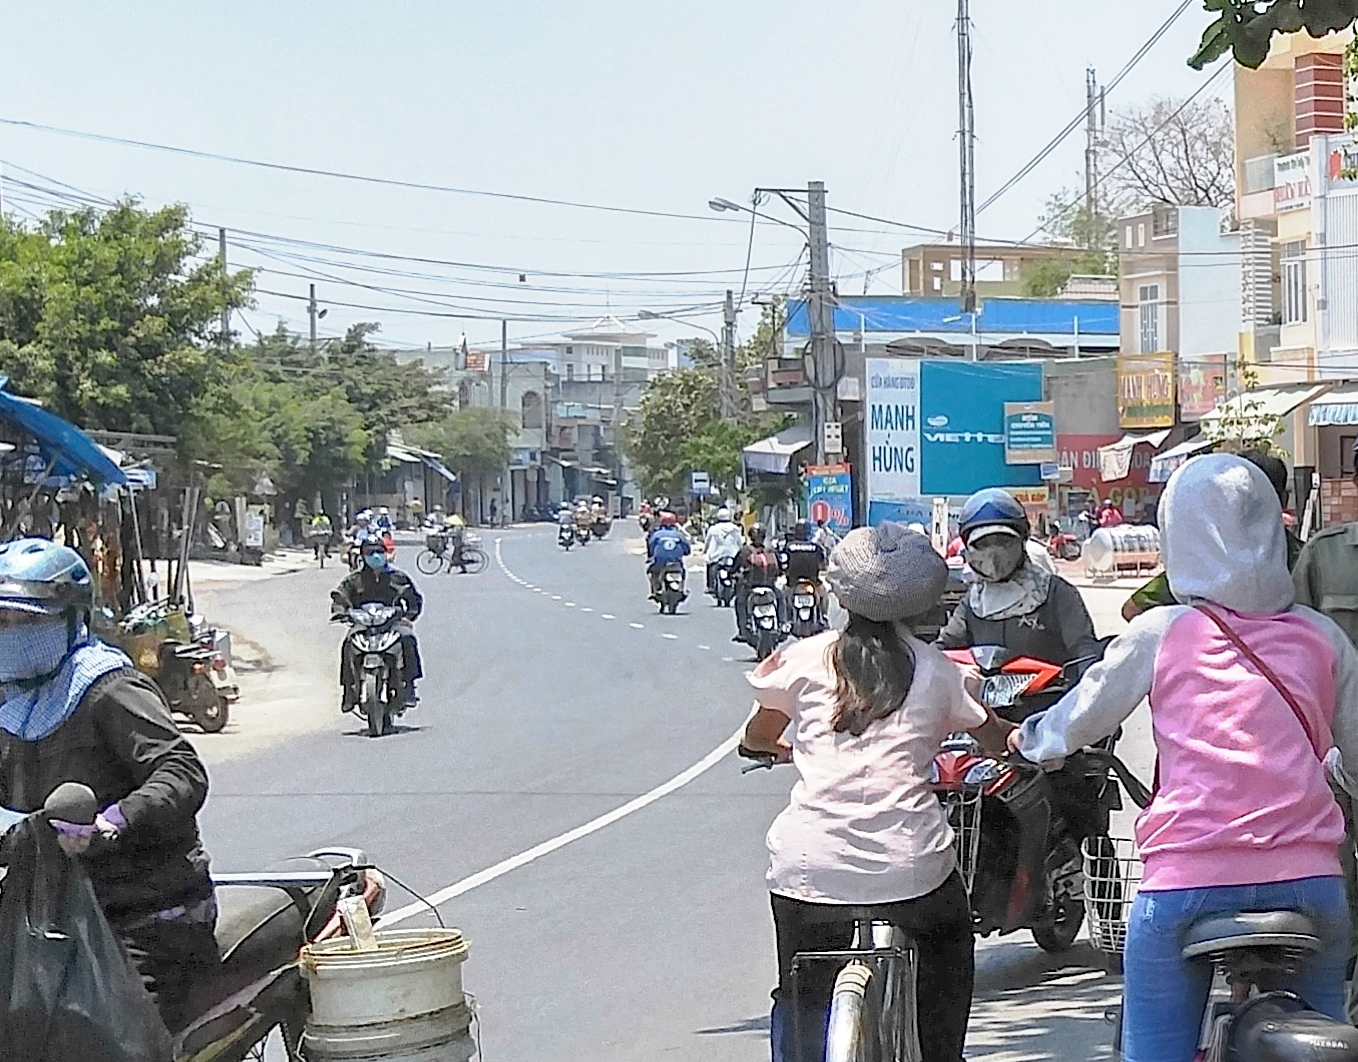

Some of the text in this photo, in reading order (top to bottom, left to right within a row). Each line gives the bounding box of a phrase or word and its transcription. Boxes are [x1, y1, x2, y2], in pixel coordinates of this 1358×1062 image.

[871, 404, 915, 437] MẠNH
[923, 432, 1005, 444] VIETTE
[872, 440, 914, 473] HÙNG
